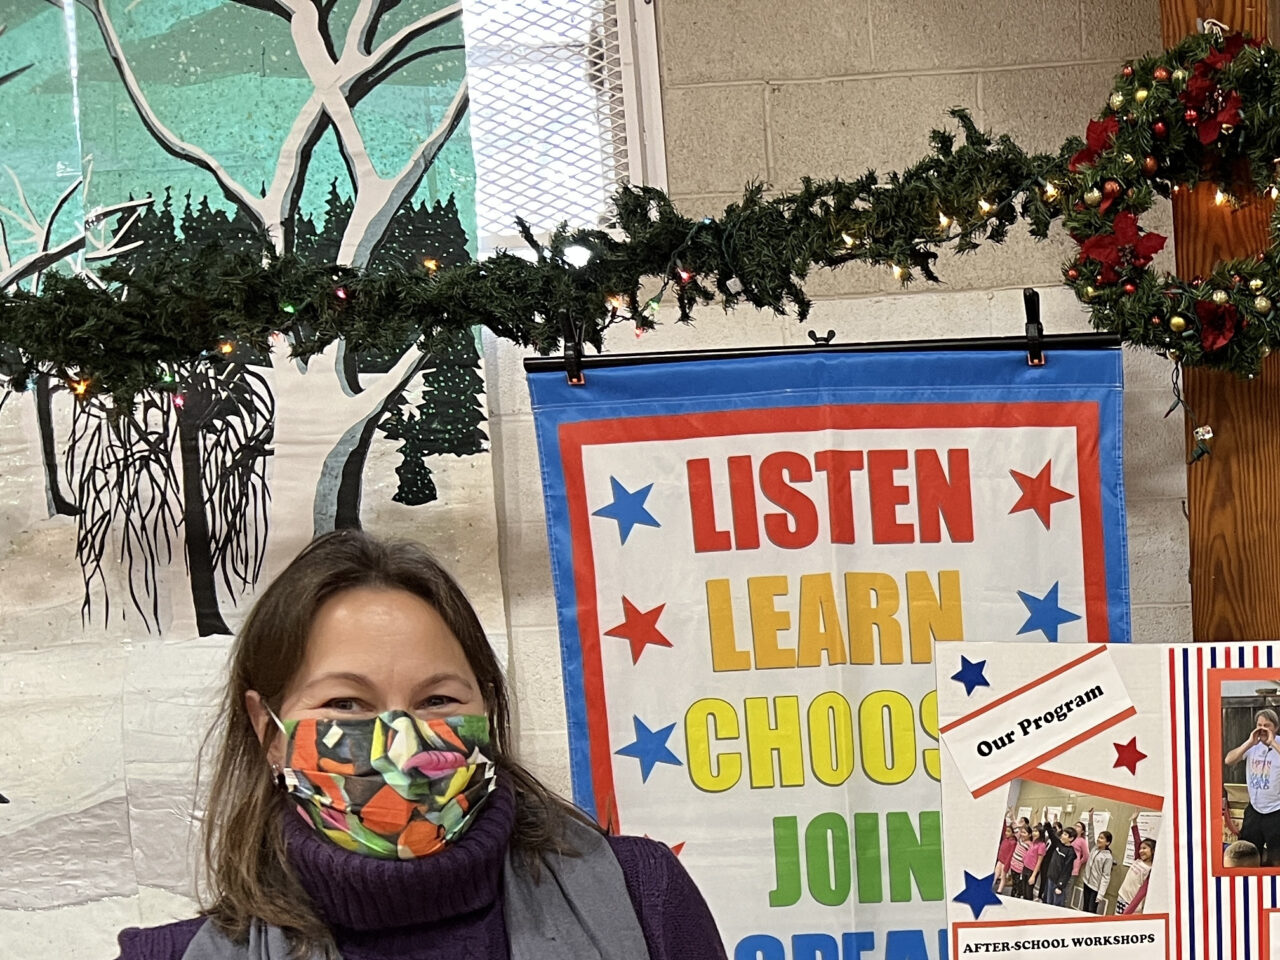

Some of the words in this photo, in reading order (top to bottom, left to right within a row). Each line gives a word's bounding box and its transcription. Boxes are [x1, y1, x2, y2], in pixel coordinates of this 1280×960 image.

[686, 448, 975, 553] LISTEN
[705, 569, 964, 673] LEARN
[976, 728, 1016, 758] Our
[1017, 684, 1104, 738] Program
[769, 810, 945, 908] JOIN
[962, 938, 1069, 954] AFTER-SCHOOL
[1070, 933, 1155, 947] WORKSHOPS
